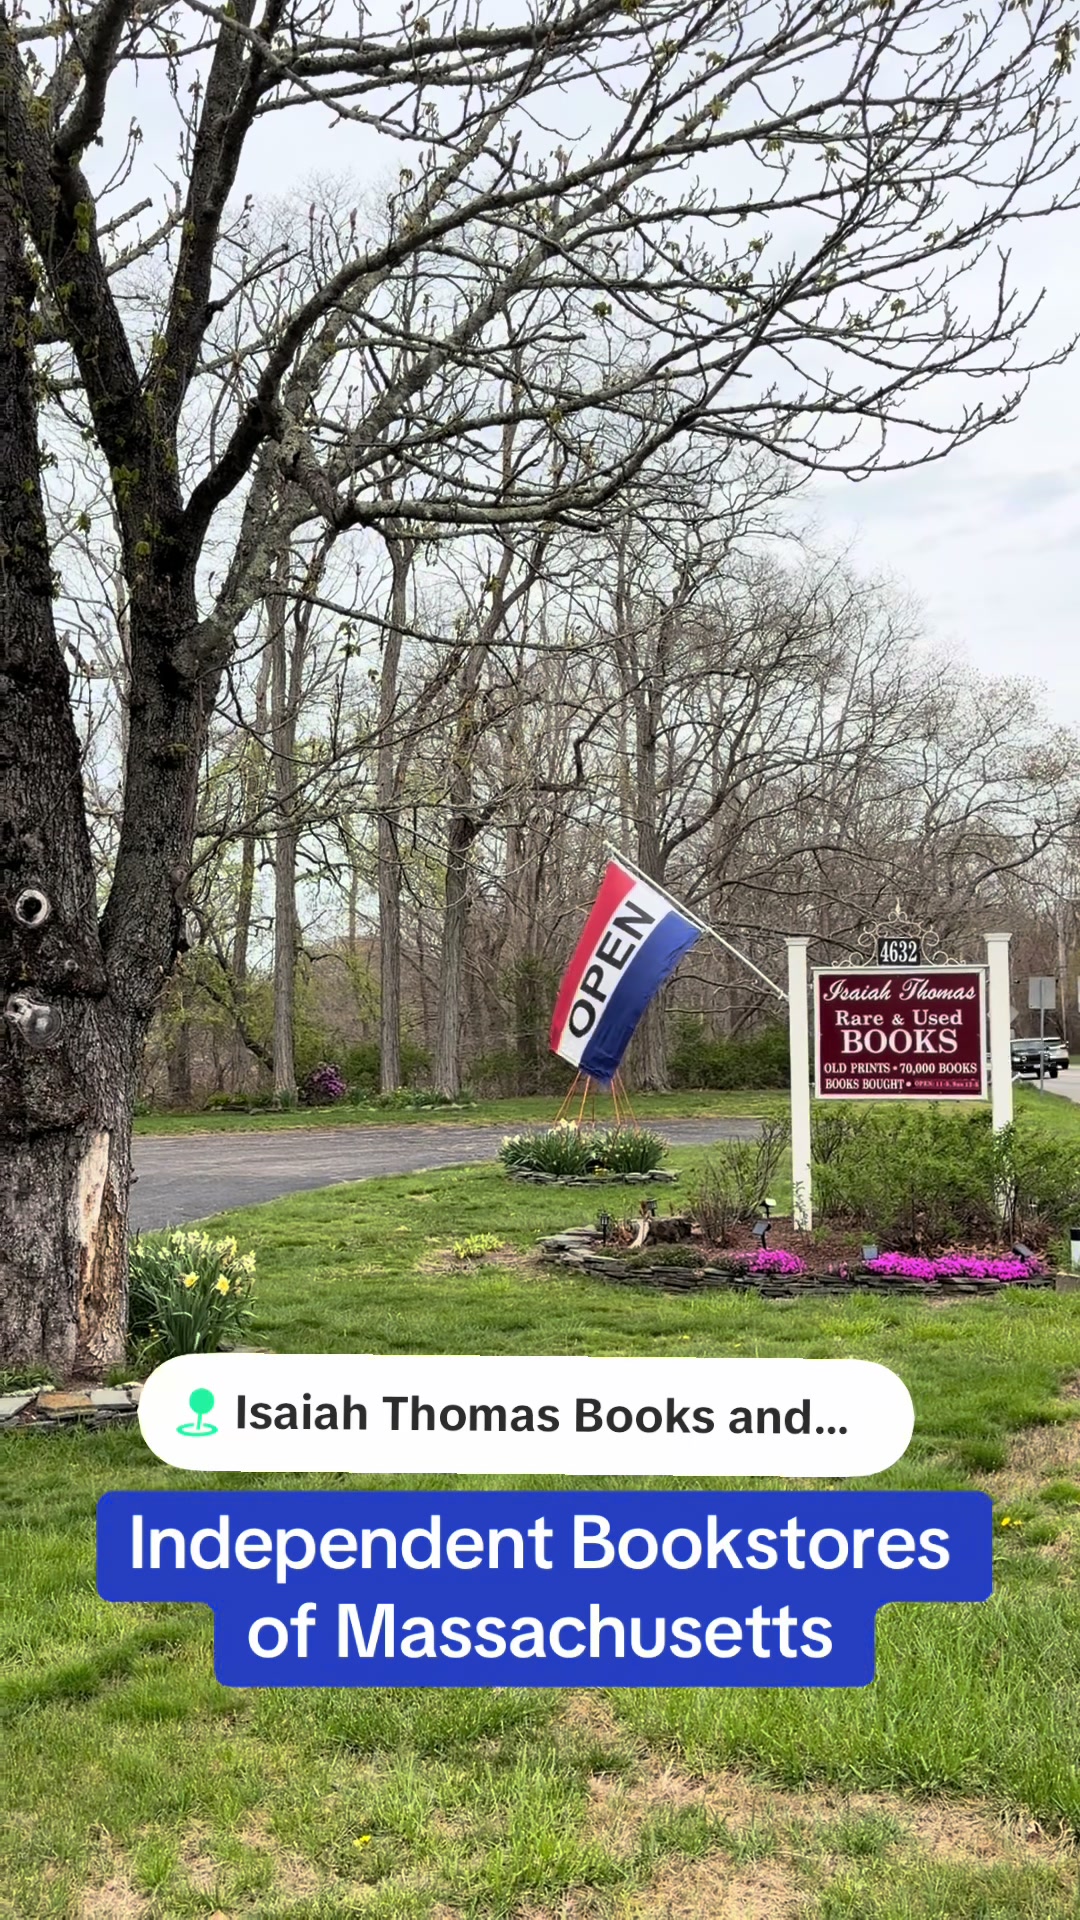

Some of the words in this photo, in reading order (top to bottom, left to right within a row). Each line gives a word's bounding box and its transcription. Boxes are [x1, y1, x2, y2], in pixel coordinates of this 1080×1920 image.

[880, 940, 918, 963] 4632
[568, 900, 656, 1038] OPEN
[823, 979, 891, 1001] Isaiah
[898, 978, 976, 1001] Thomas
[835, 1010, 884, 1026] Rare
[891, 1013, 905, 1026] &
[912, 1009, 963, 1026] Used
[841, 1029, 958, 1054] BOOKS
[824, 1063, 847, 1074] OLD
[850, 1063, 891, 1074] PRINTS
[900, 1063, 936, 1075] 70,000
[938, 1063, 978, 1074] BOOKS
[825, 1078, 860, 1090] BOOKS
[862, 1078, 905, 1090] BOUGHT
